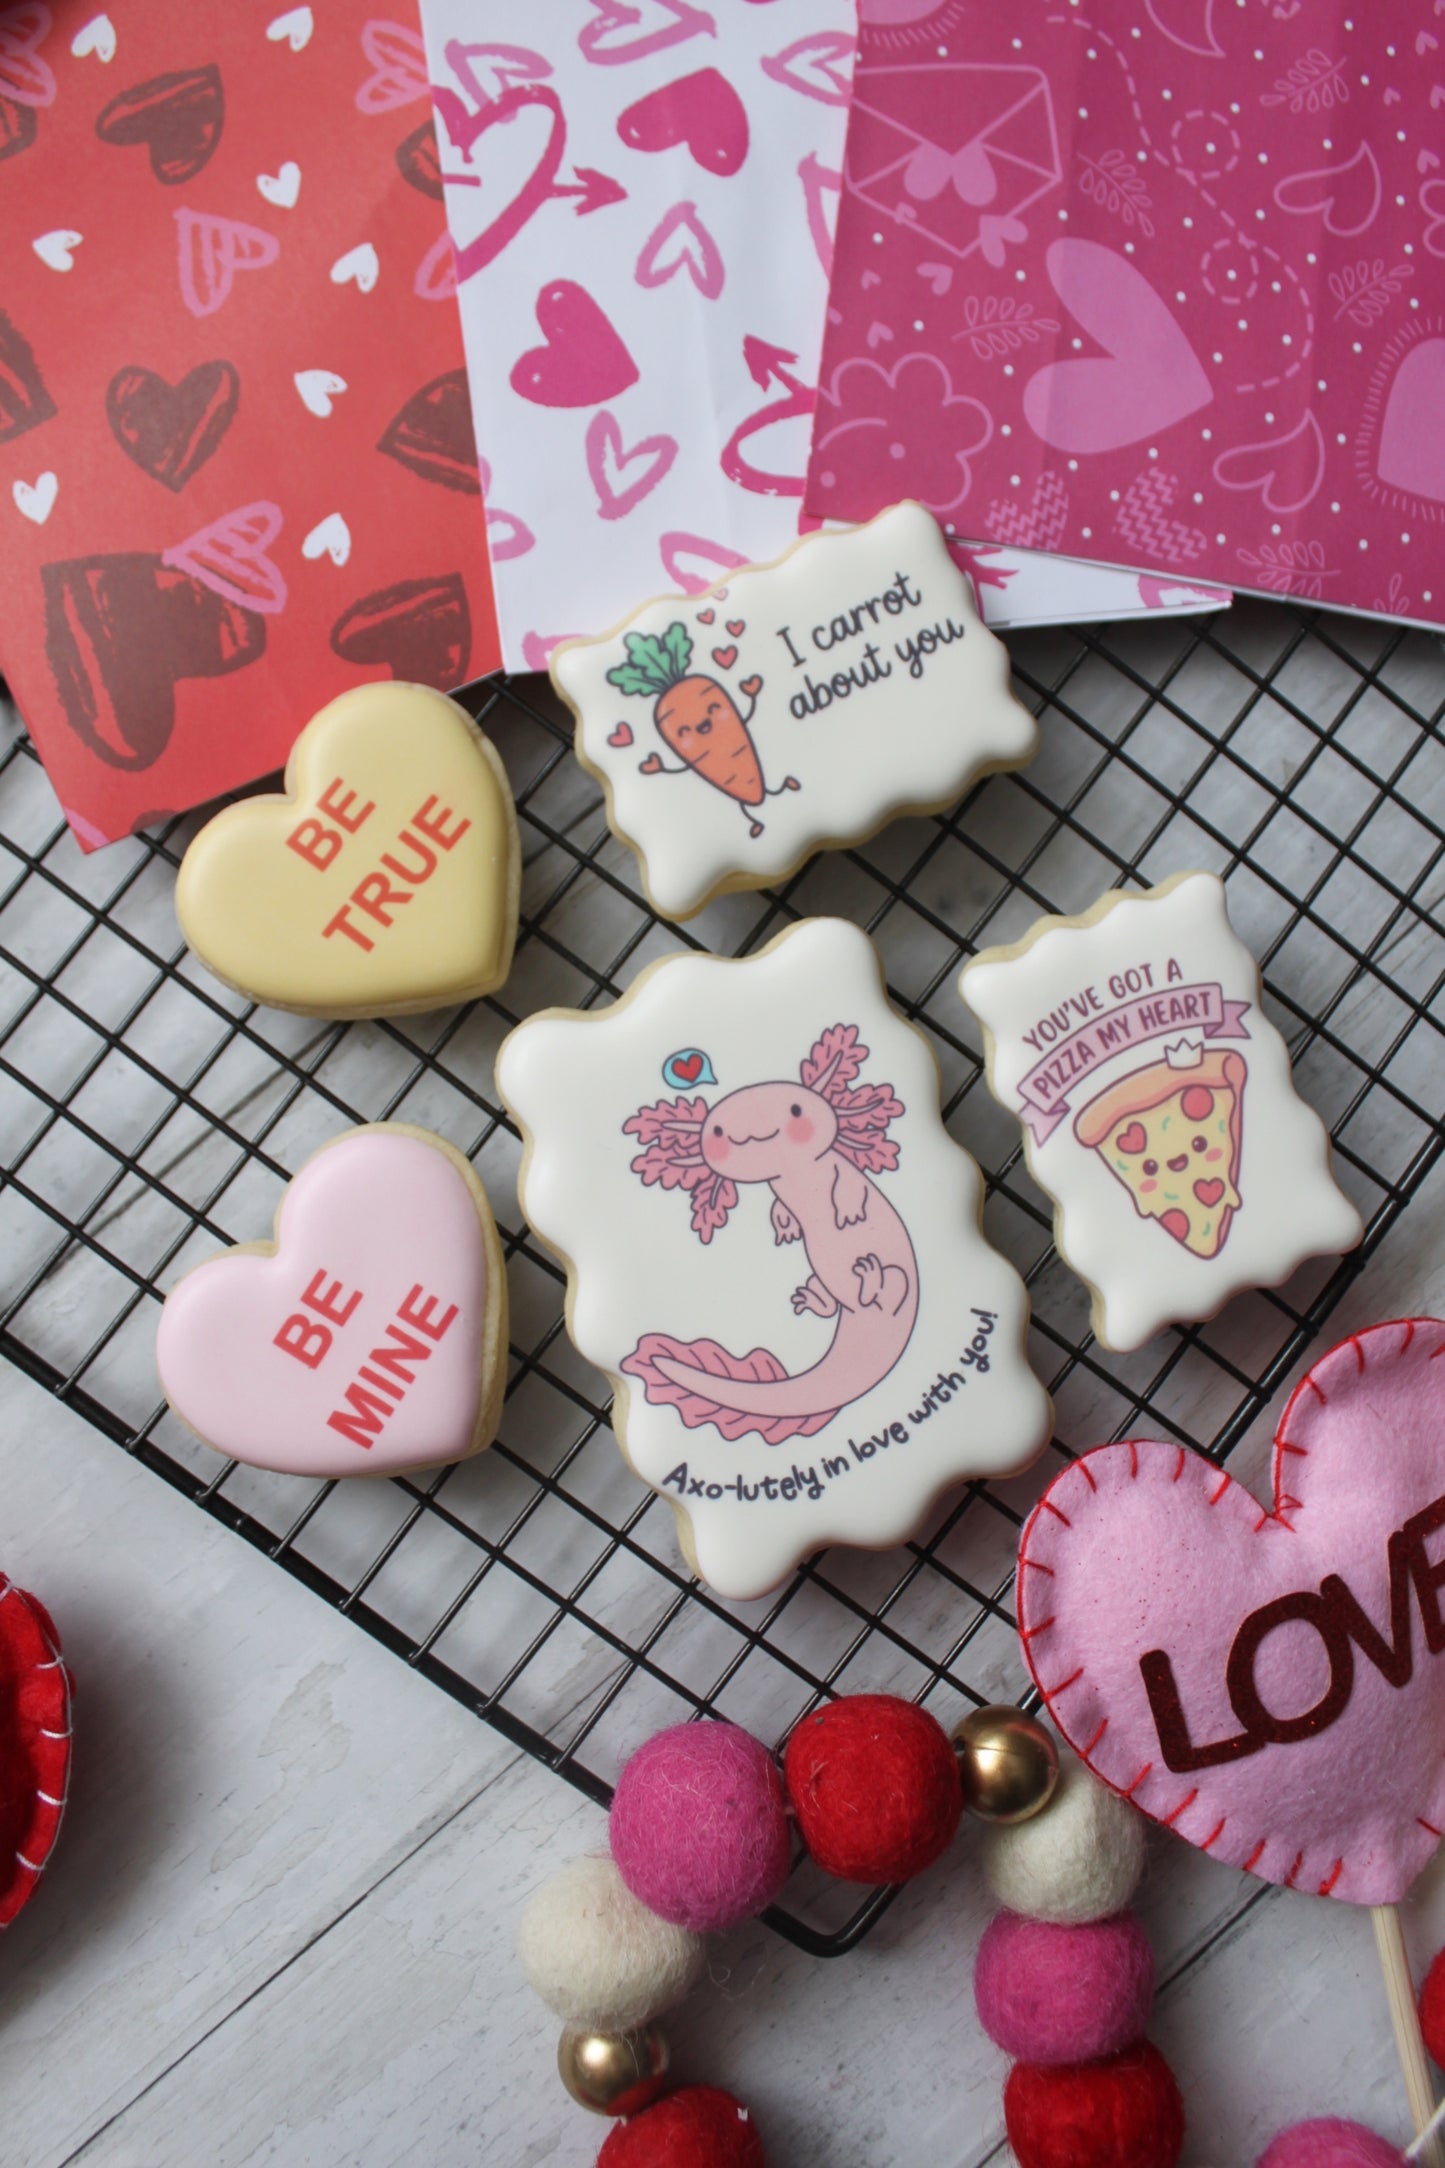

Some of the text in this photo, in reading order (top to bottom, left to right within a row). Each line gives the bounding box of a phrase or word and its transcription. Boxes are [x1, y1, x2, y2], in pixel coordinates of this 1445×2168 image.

[776, 571, 922, 667] I carrot
[789, 618, 965, 720] about you
[285, 776, 377, 873] BE
[321, 793, 472, 953] TRUE
[1022, 958, 1183, 1051] YOU'VE GOT A
[1032, 991, 1211, 1099] PIZZA MY HEART
[272, 1268, 364, 1370] BE
[326, 1283, 460, 1450] MINE
[662, 1307, 999, 1501] Axo-lutely in love with you!
